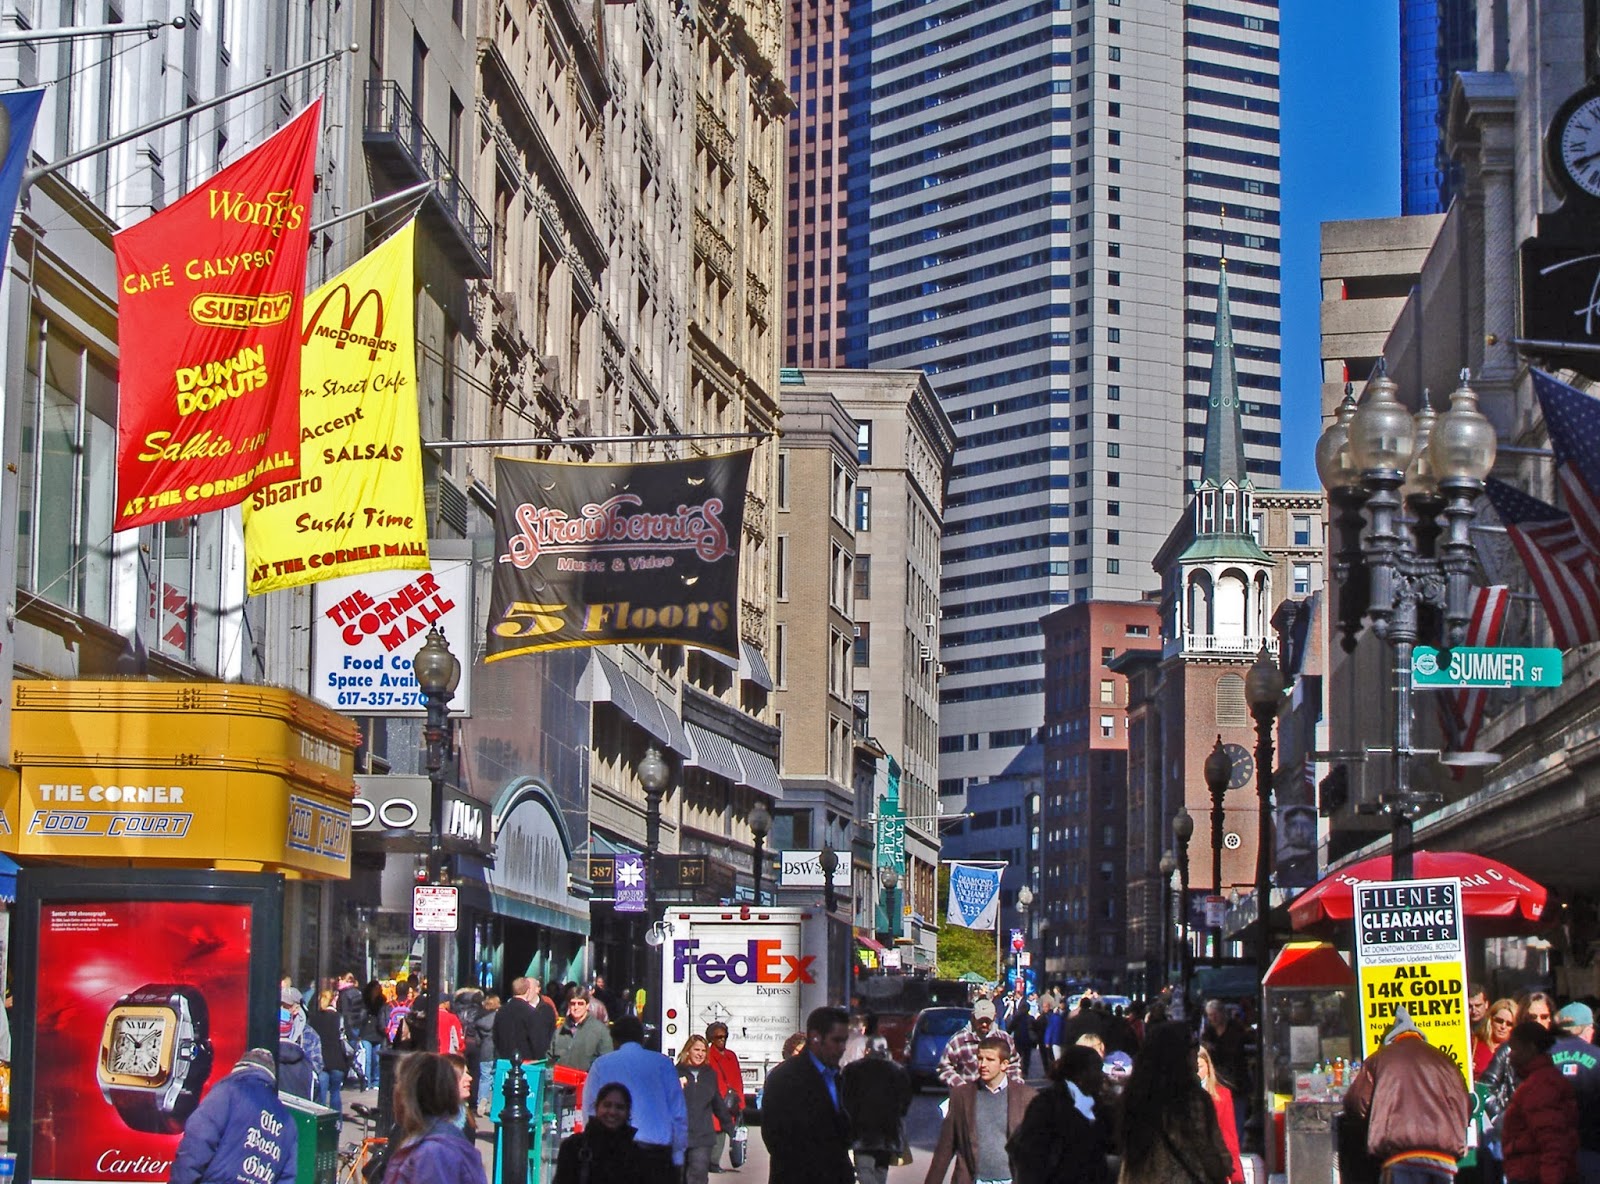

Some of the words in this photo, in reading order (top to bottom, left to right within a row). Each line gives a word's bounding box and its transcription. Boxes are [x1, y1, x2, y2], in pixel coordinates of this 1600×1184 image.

[123, 264, 174, 294] CAFÉ
[314, 325, 397, 353] McDonald's
[322, 379, 367, 398] Street
[373, 370, 408, 394] Cafe
[301, 407, 364, 443] Accent
[323, 444, 404, 464] SALSAS
[122, 497, 143, 517] AT
[149, 489, 181, 509] THE
[185, 469, 254, 502] CORNER
[254, 451, 294, 478] MALL
[252, 475, 322, 512] Sbarro
[295, 512, 355, 534] Sushi
[364, 507, 414, 530] Time
[251, 565, 269, 582] AT
[272, 557, 306, 576] THE
[308, 543, 381, 568] CORNER
[384, 542, 426, 557] MALL
[557, 557, 605, 572] Music
[612, 558, 625, 572] &
[628, 556, 675, 571] Video
[325, 590, 375, 627] THE
[342, 572, 441, 646] CORNER
[492, 601, 568, 638] 5
[581, 601, 730, 632] Floors
[378, 594, 455, 652] MALL
[344, 655, 383, 669] Food
[1449, 652, 1524, 681] SUMMER
[1531, 667, 1543, 681] ST
[328, 672, 373, 689] Space
[380, 672, 419, 687] Avail
[337, 691, 429, 706] 617-357-570
[39, 784, 85, 802] THE
[88, 785, 184, 804] CORNER
[27, 810, 90, 834] FOOD
[107, 814, 187, 837] COURT
[884, 814, 896, 854] PLACE
[592, 867, 611, 877] 387
[784, 862, 814, 875] DSW
[962, 904, 980, 916] 333
[1363, 909, 1454, 929] CLEARANCE
[1364, 928, 1450, 943] CENTER
[1372, 944, 1405, 953] DOWNTOWN
[1435, 942, 1457, 950] BOSTON
[673, 939, 817, 984] FedEx
[1407, 954, 1433, 962] Updated
[1394, 966, 1431, 979] ALL
[756, 985, 791, 997] Express
[1367, 982, 1404, 998] 14K
[1410, 979, 1462, 996] GOLD
[1368, 998, 1461, 1018] JEWELRY!
[261, 1110, 283, 1137] The
[96, 1149, 172, 1174] Cartier
